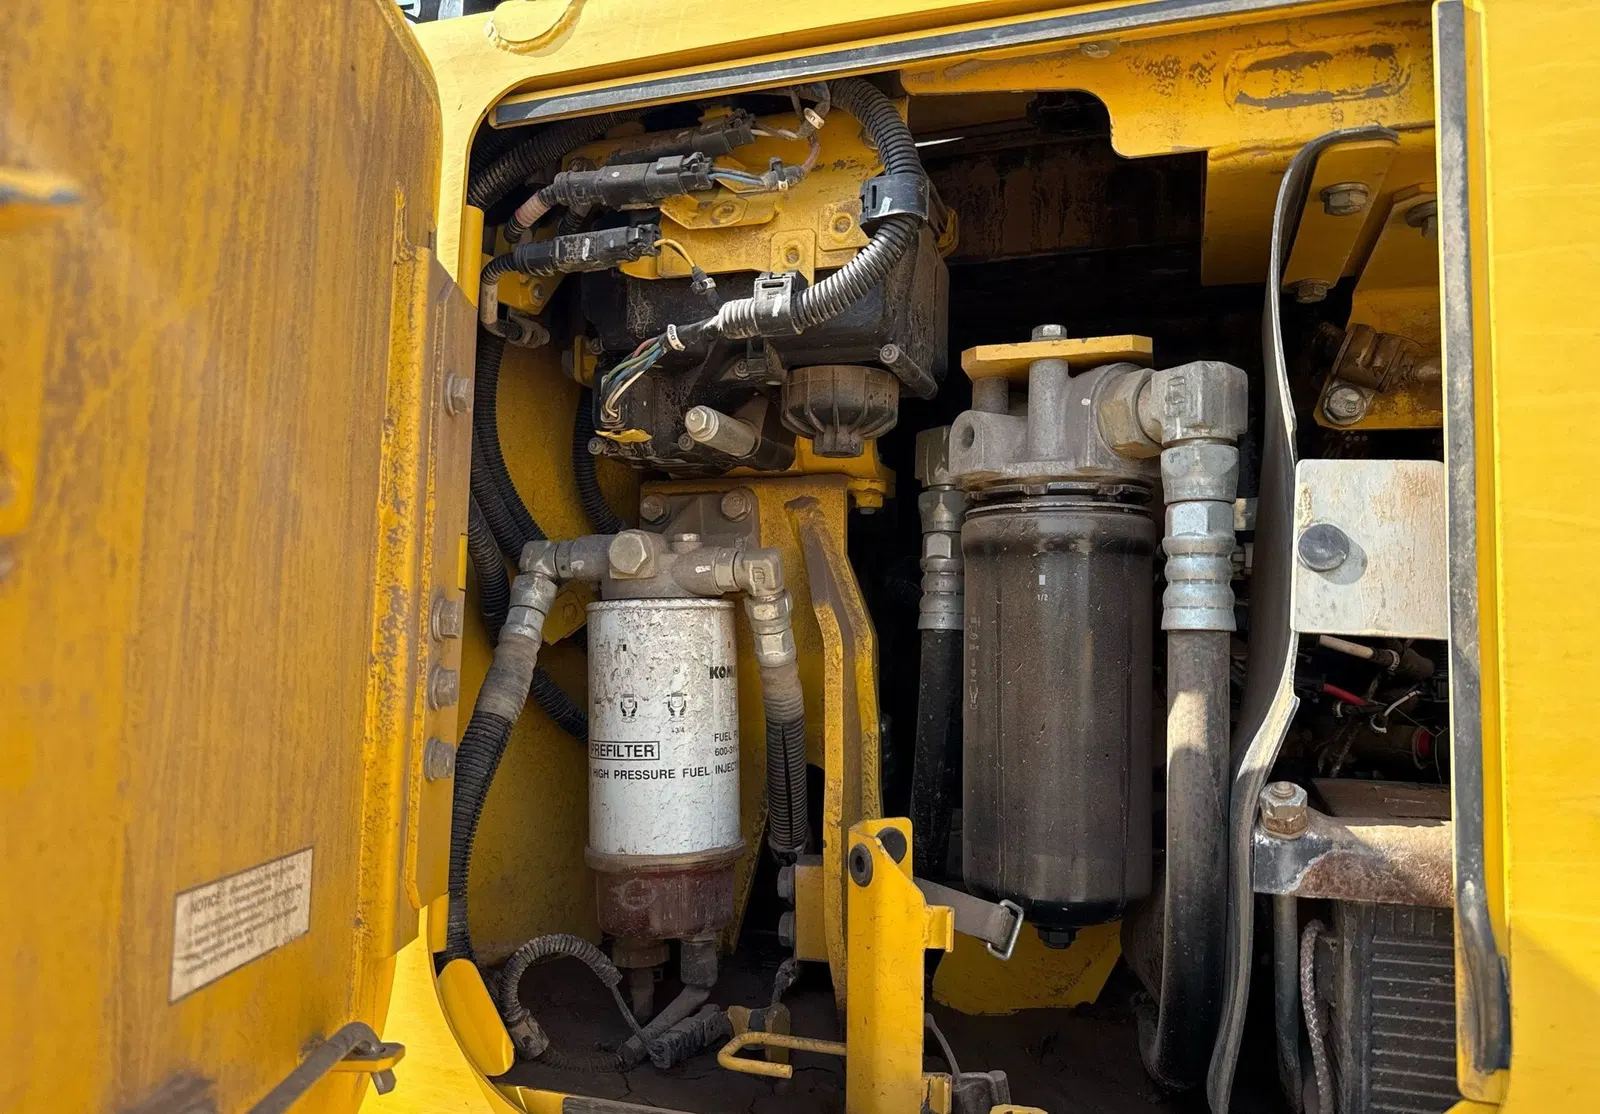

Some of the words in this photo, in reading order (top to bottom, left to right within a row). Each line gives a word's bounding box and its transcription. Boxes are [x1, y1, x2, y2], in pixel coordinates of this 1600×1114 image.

[1037, 593, 1048, 601] 1/2
[714, 732, 731, 742] FUEL
[591, 743, 654, 757] PREFILTER
[613, 769, 675, 780] PRESSURE
[683, 766, 710, 778] FUEL
